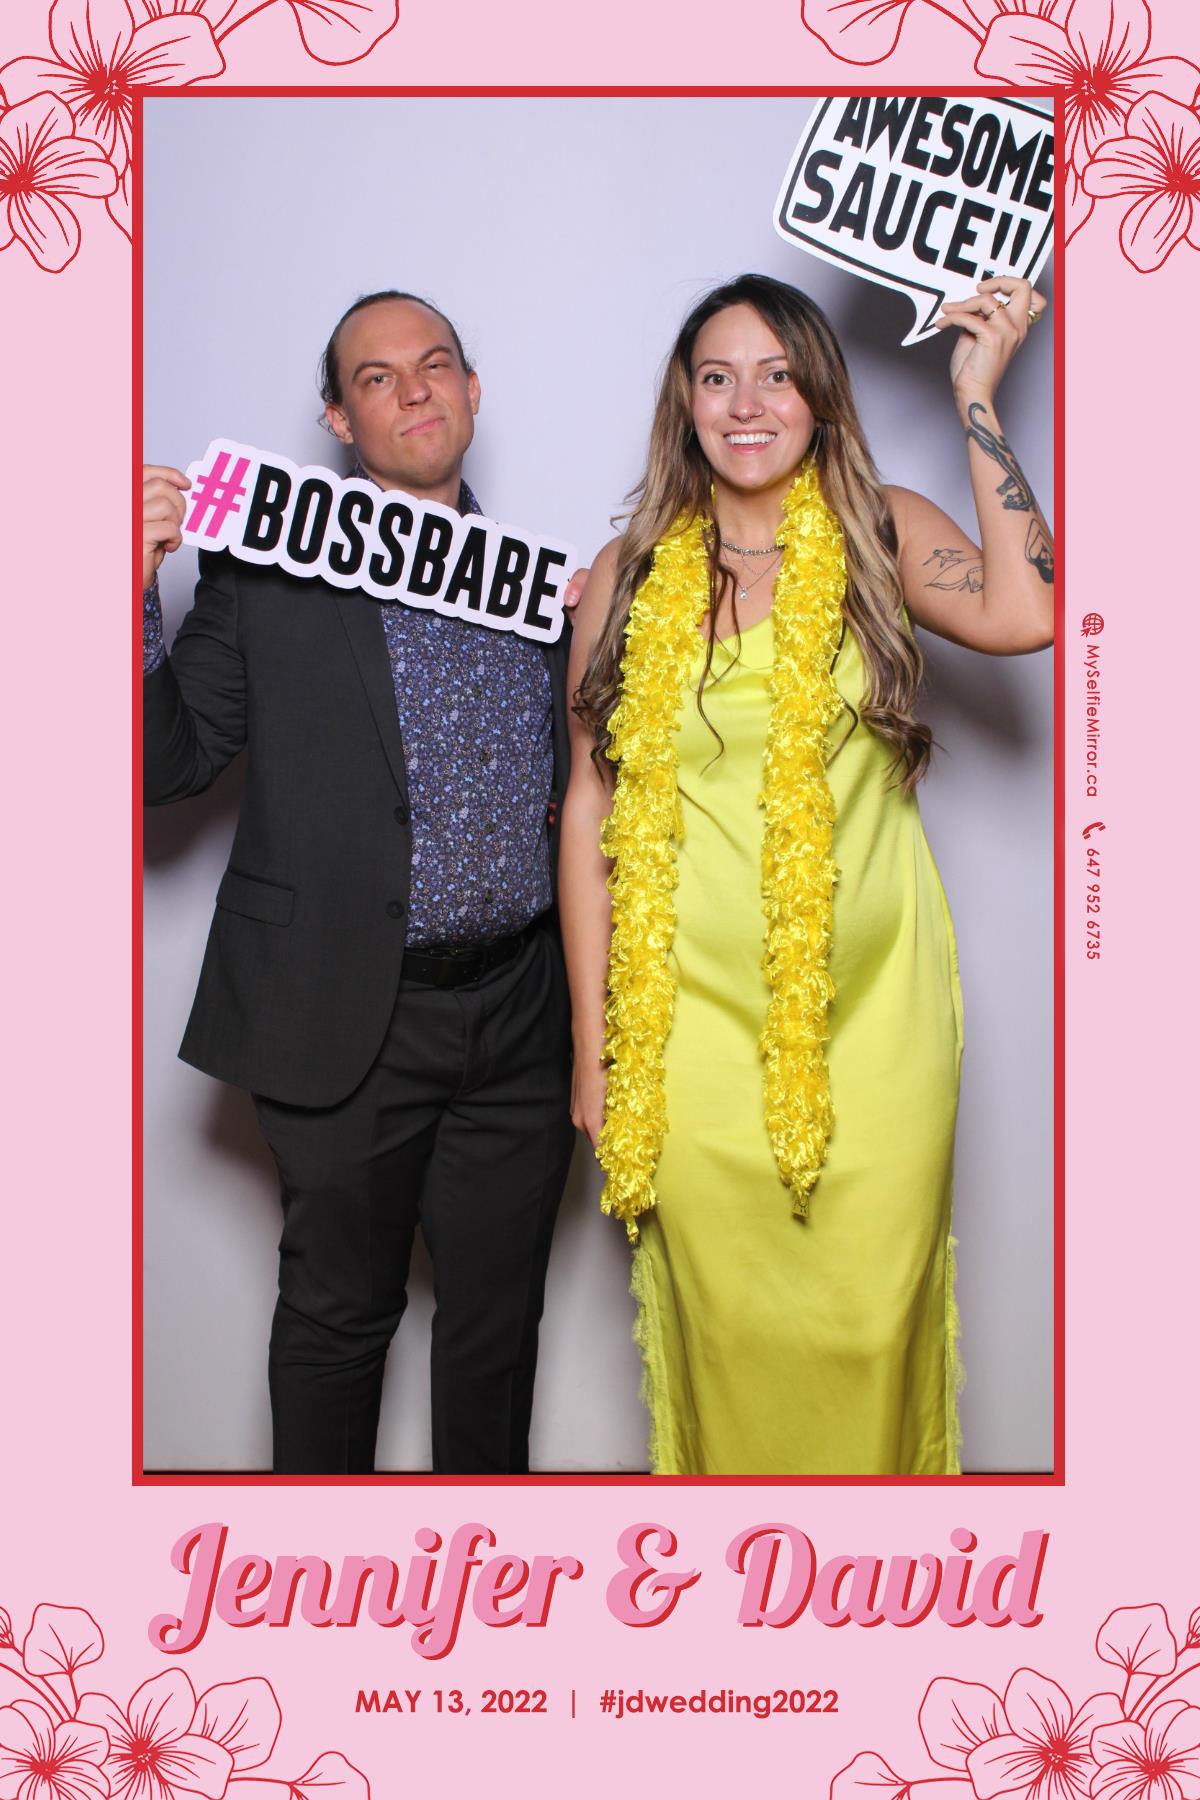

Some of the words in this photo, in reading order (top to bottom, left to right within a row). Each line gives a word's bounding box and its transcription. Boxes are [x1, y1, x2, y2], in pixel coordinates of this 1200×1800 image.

[792, 149, 1032, 281] SAUCE!!
[833, 97, 1054, 212] AWESOME
[185, 451, 567, 631] #BOSSBABE
